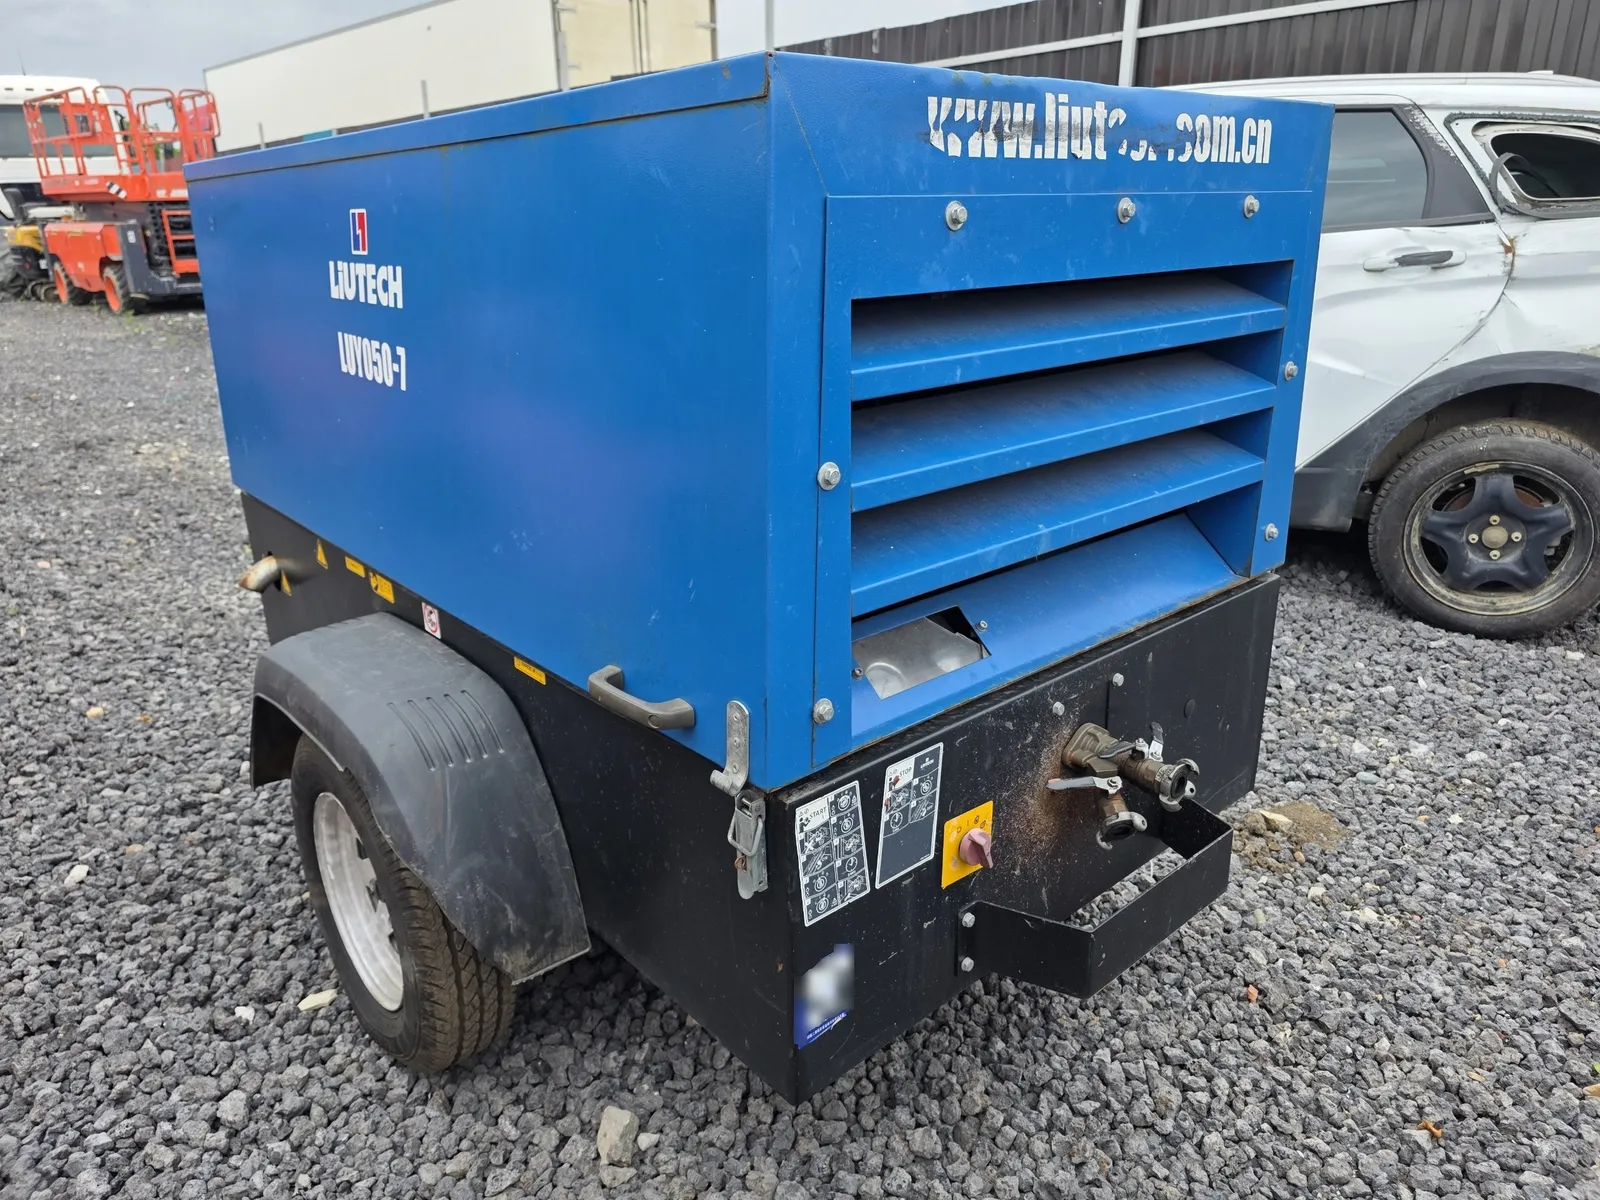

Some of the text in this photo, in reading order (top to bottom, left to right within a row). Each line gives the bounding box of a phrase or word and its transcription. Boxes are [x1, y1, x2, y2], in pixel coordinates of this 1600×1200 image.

[338, 331, 406, 391] LUY050-7
[899, 766, 912, 777] STOP
[809, 806, 827, 820] START
